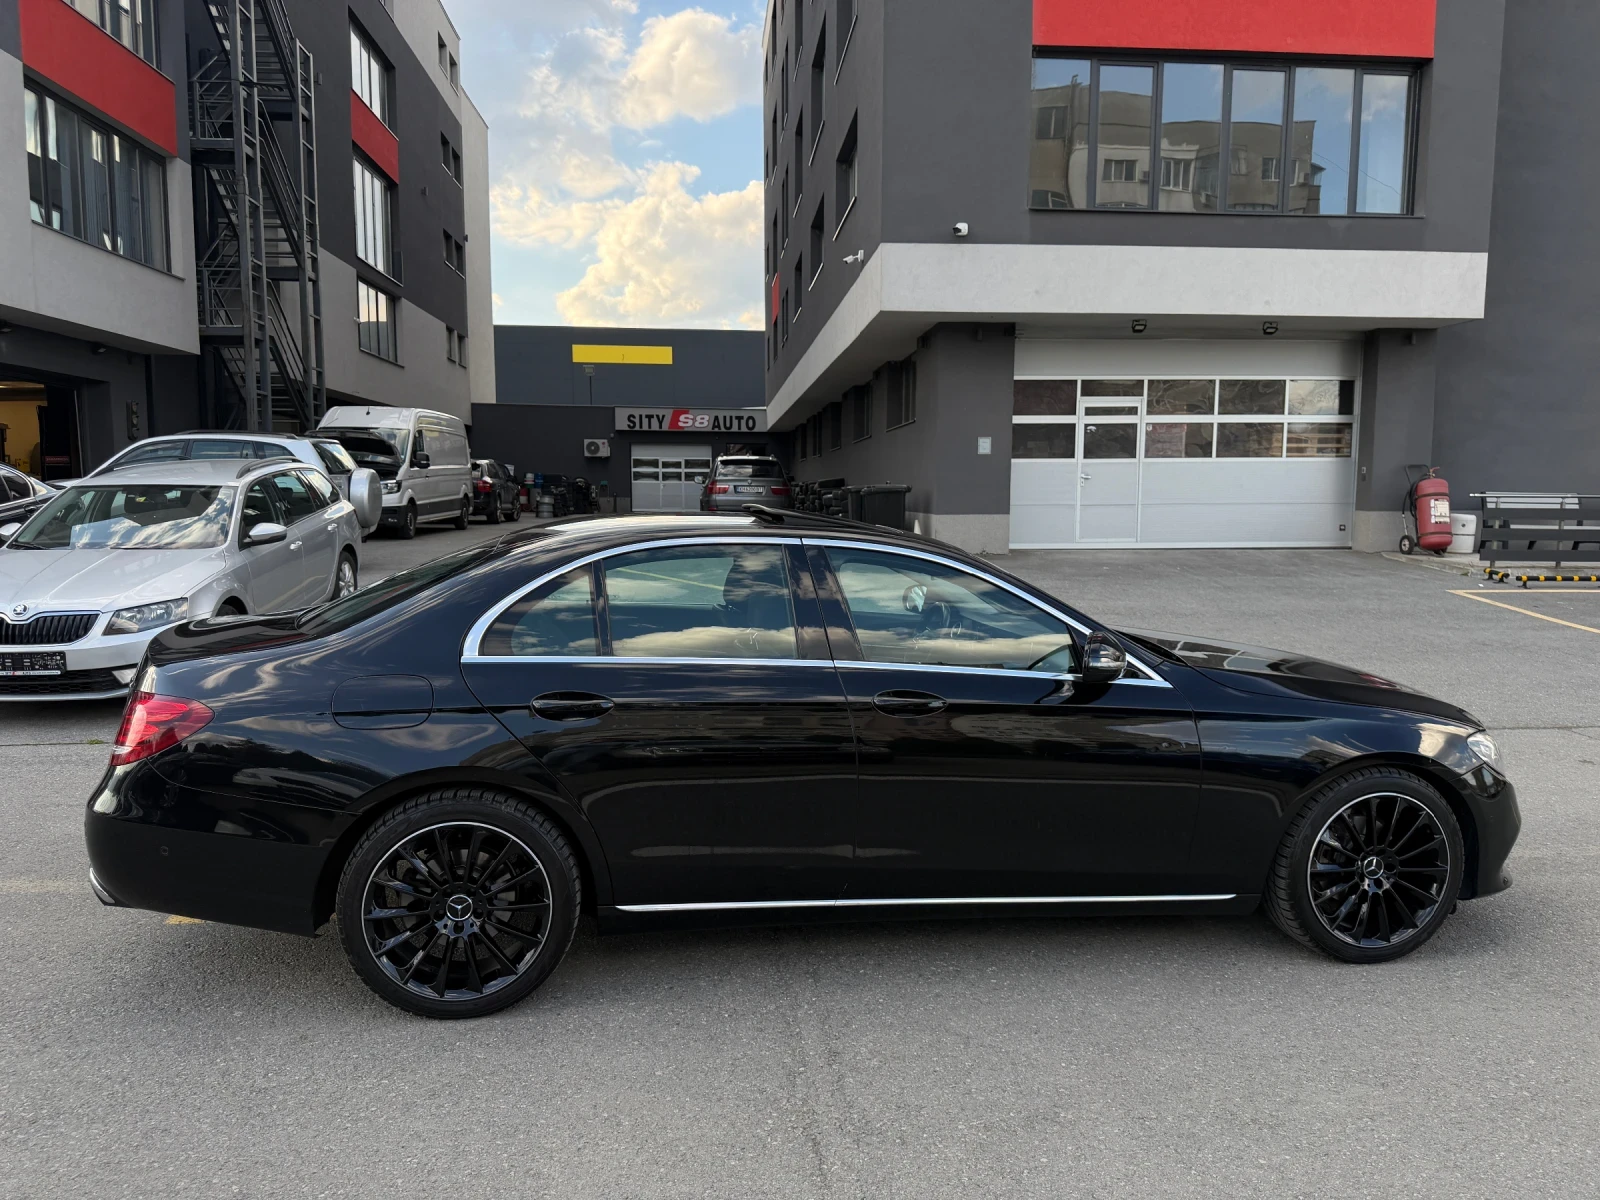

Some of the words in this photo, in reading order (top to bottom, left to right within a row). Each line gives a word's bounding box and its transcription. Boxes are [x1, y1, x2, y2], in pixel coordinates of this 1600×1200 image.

[627, 414, 665, 429] SITY
[678, 414, 709, 428] S8
[711, 415, 756, 431] AUTO
